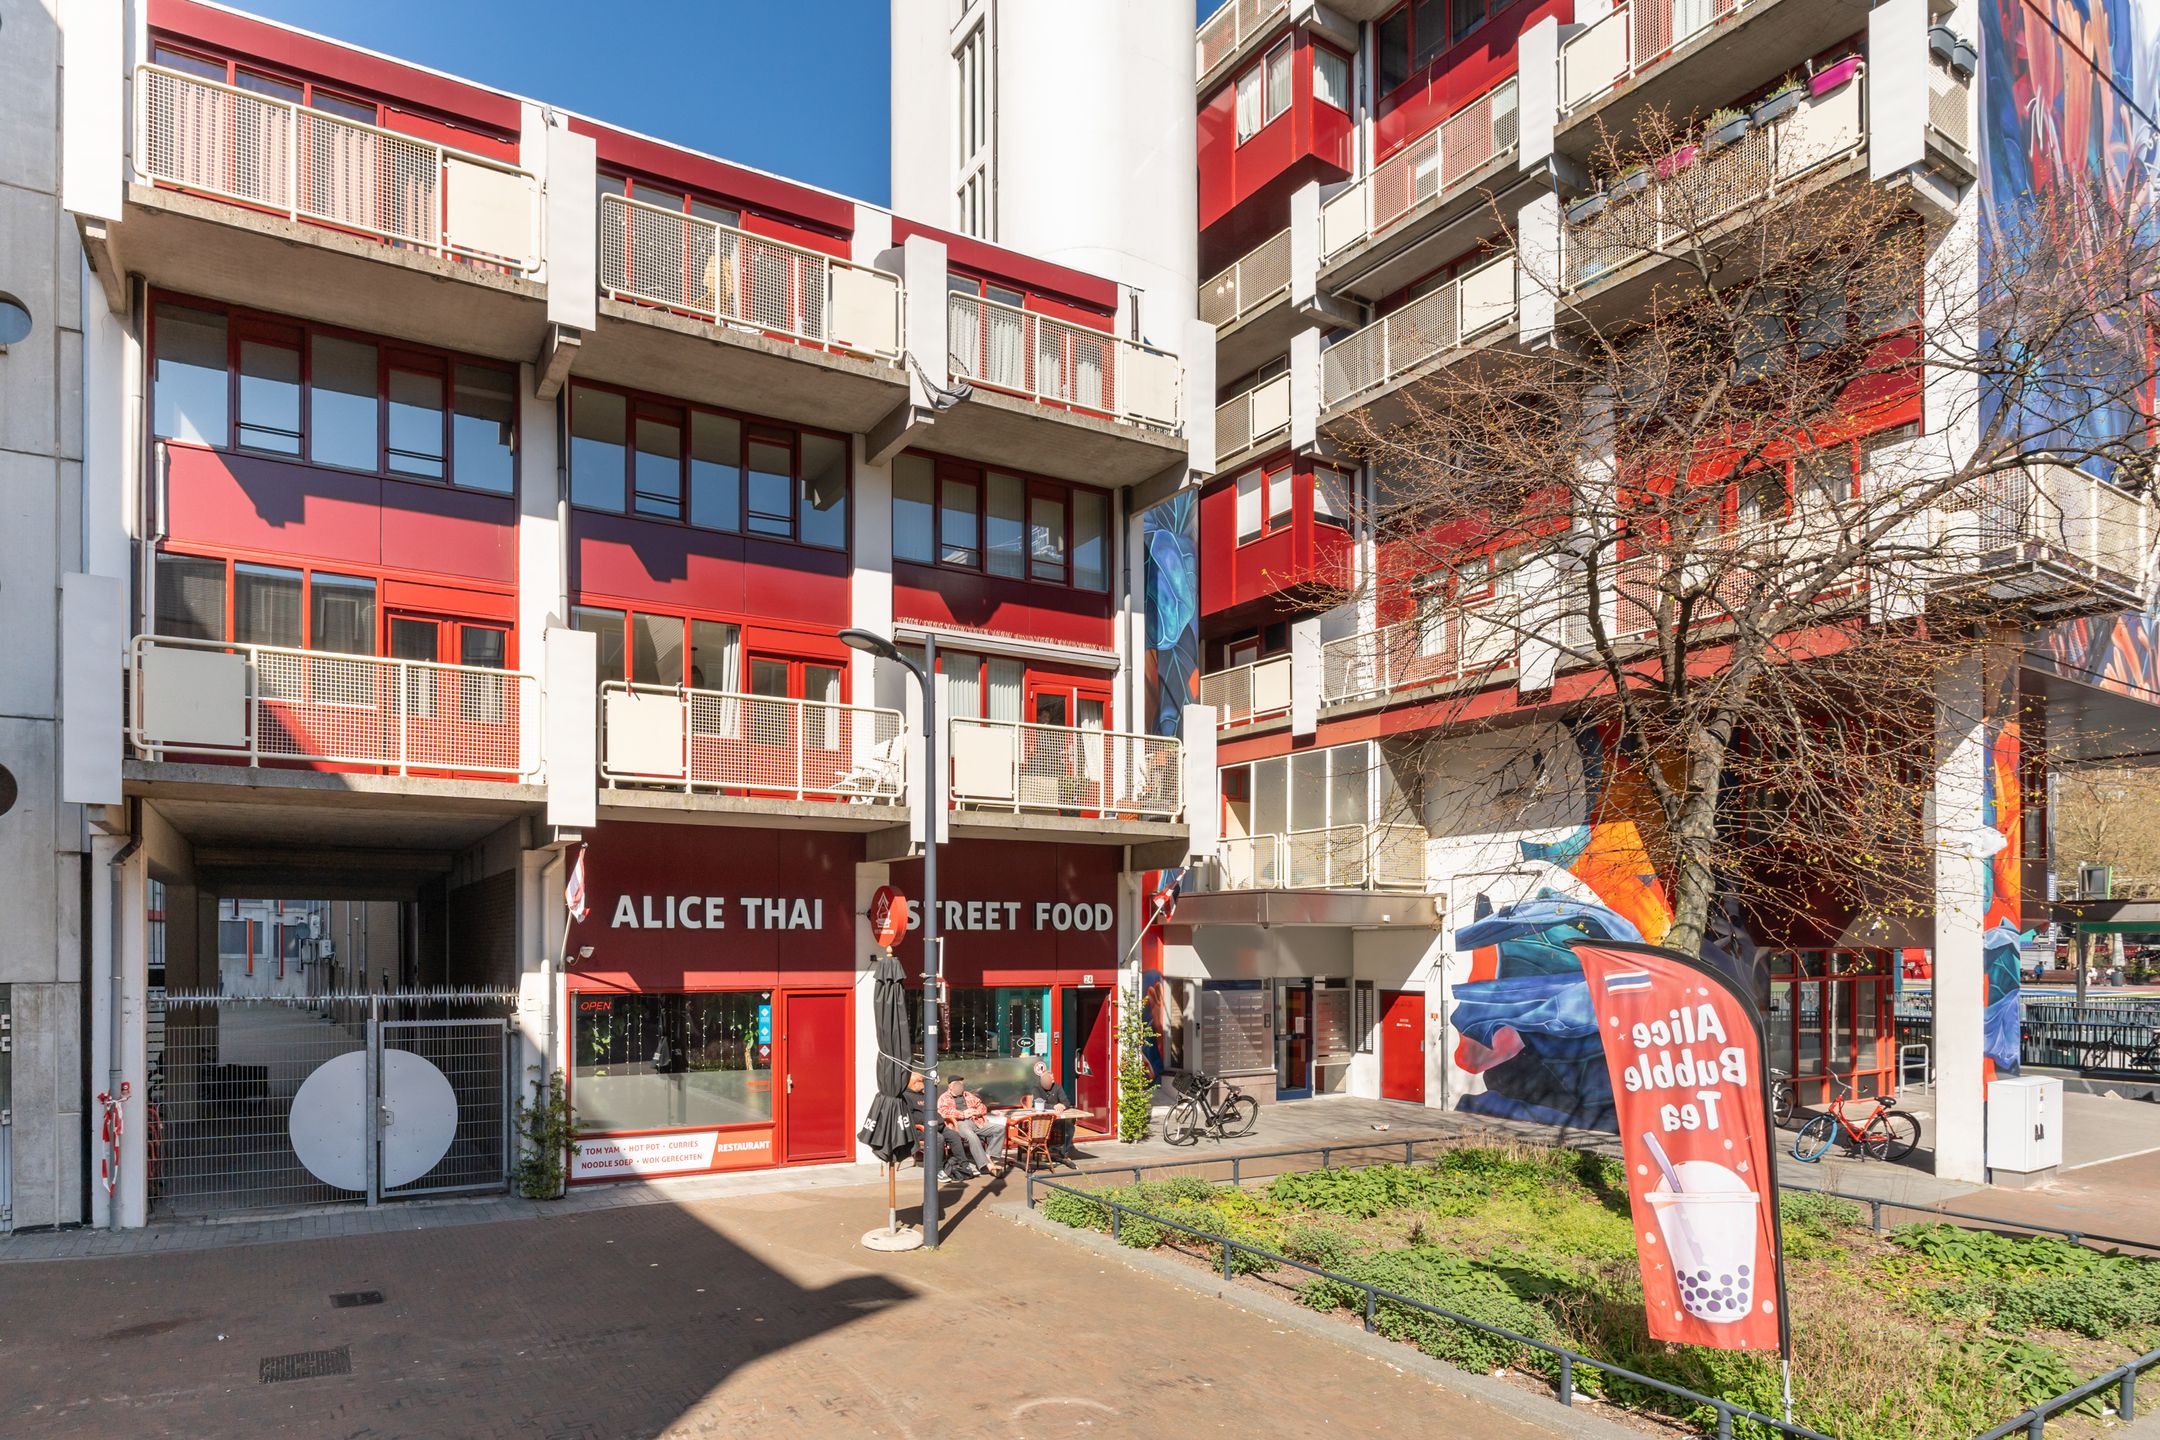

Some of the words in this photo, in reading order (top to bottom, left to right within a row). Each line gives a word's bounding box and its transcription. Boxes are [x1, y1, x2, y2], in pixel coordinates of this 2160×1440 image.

[611, 894, 725, 930] ALICE
[740, 897, 823, 931] THAI
[1035, 902, 1114, 932] FOOD
[1085, 976, 1092, 984] 24
[580, 1000, 612, 1011] OPEN
[585, 1147, 603, 1155] TOM
[604, 1146, 620, 1154] YAM
[628, 1144, 643, 1152] HOT
[646, 1143, 660, 1151] POT
[668, 1140, 699, 1150] CURRIES
[717, 1140, 770, 1152] RESTAURANT
[581, 1160, 613, 1169] NOODLE
[614, 1158, 634, 1167] SOEP
[642, 1156, 659, 1165] WOK
[661, 1153, 703, 1163] GERECHTEN
